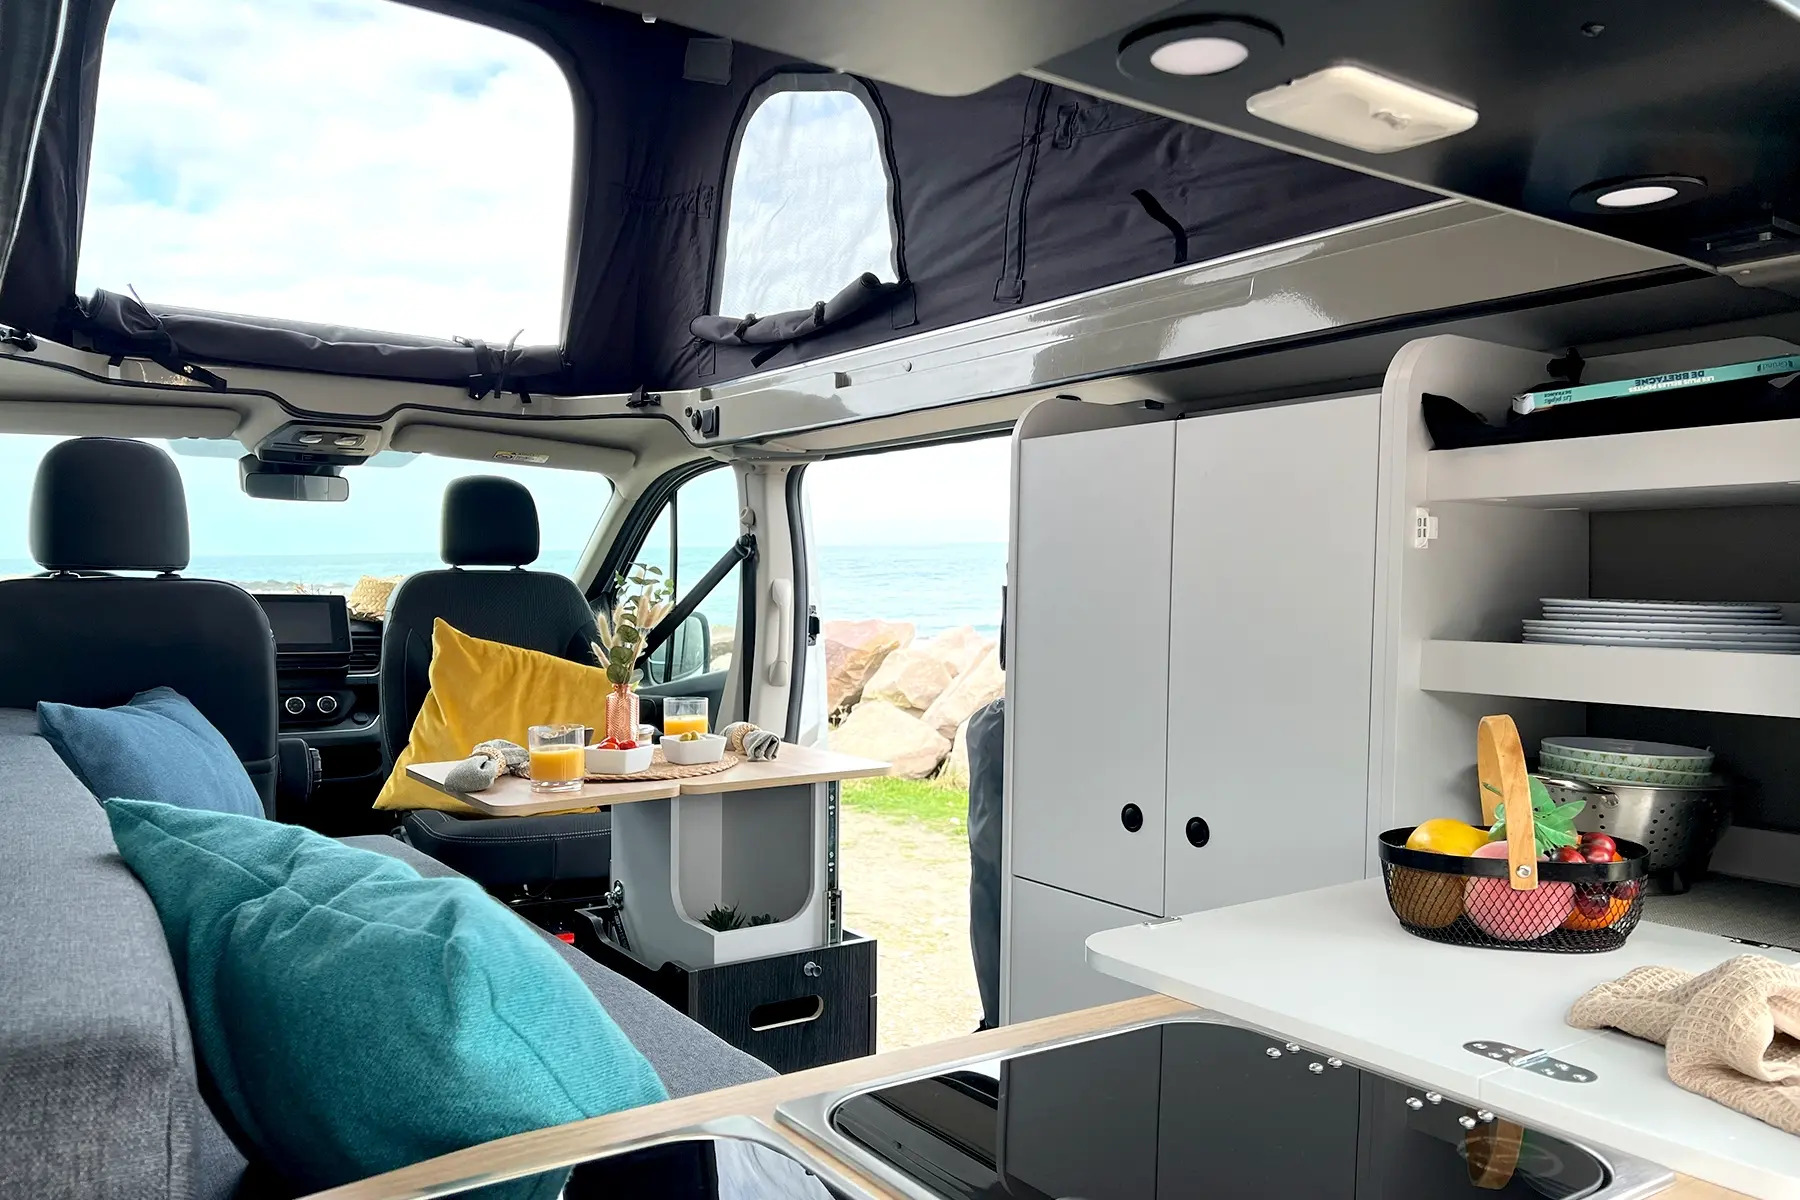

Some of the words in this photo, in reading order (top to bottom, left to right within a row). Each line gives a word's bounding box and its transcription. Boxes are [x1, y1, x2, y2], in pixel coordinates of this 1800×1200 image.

[1691, 370, 1705, 378] DE
[1634, 372, 1690, 386] BRETAGNE
[1682, 377, 1702, 385] PLUS
[1657, 380, 1683, 389] BELLES
